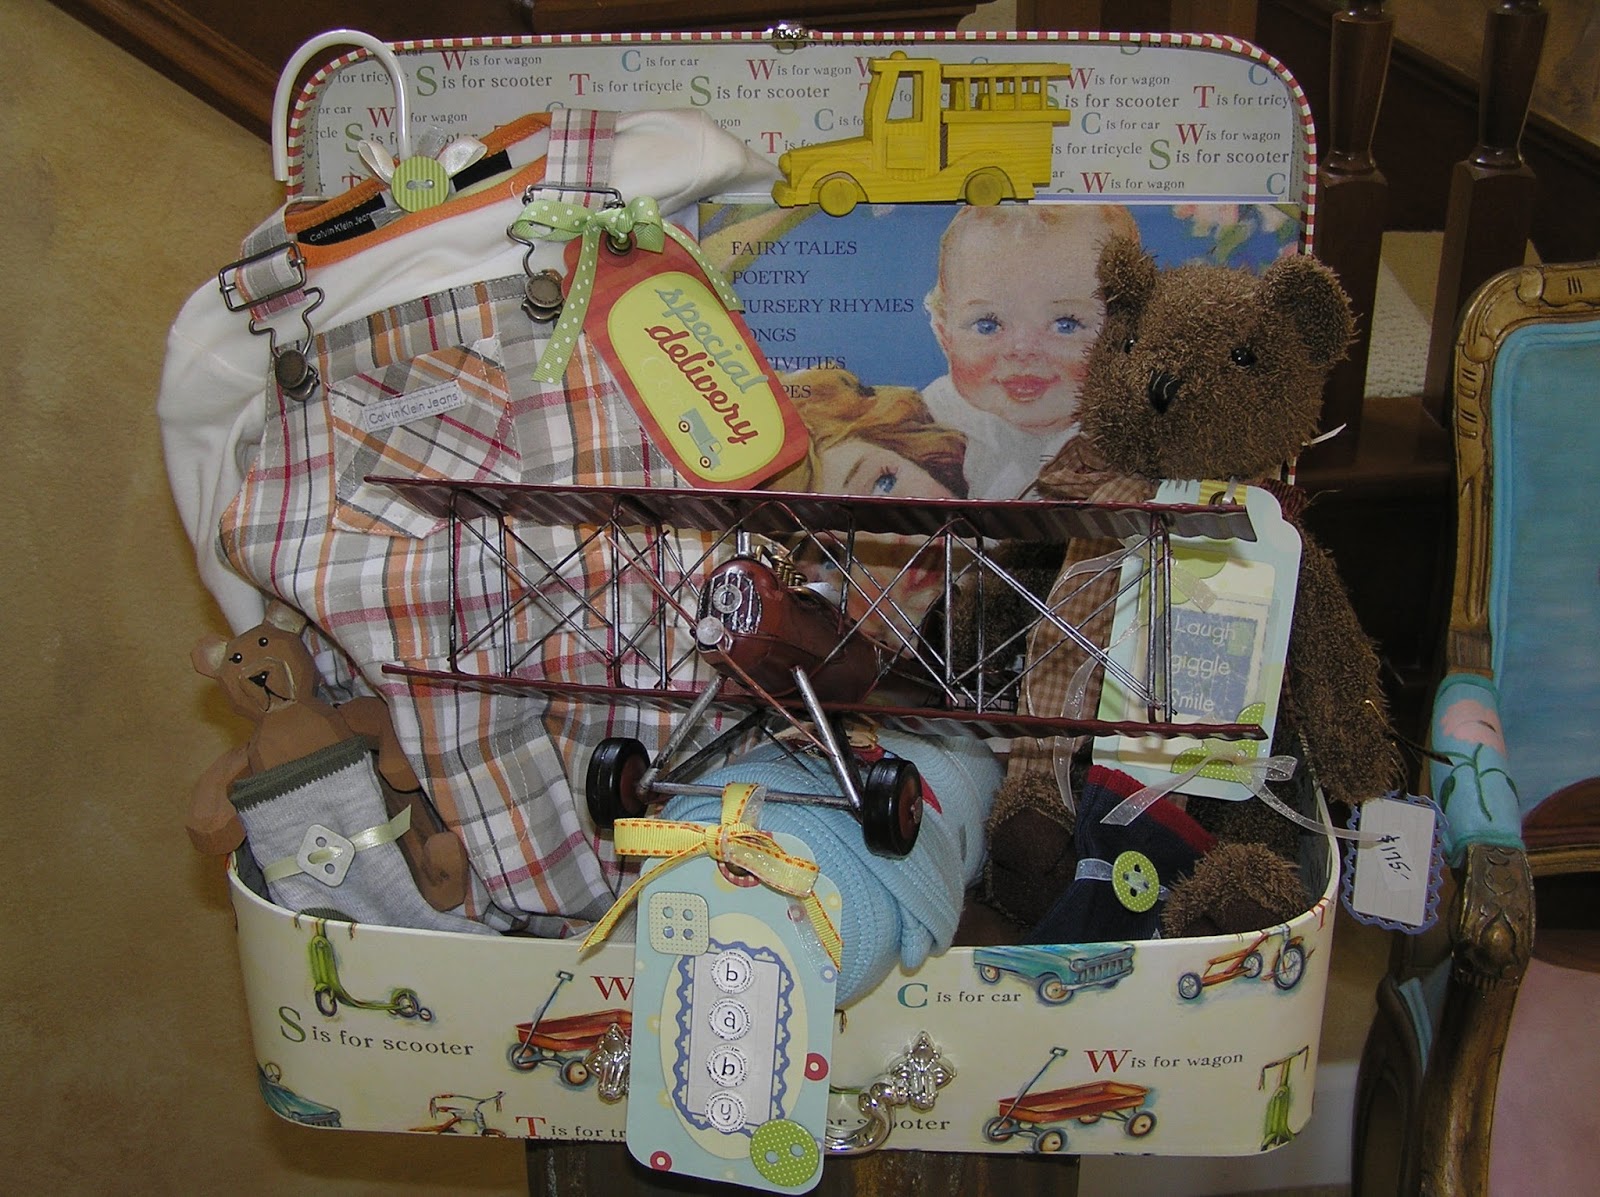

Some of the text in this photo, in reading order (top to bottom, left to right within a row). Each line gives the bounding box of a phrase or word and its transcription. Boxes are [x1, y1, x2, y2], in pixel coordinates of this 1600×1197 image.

[441, 50, 542, 71] W is for wagon
[621, 49, 699, 72] C is for car
[746, 59, 777, 80] W
[777, 65, 788, 76] is
[792, 64, 810, 75] for
[813, 66, 852, 78] wagon
[416, 66, 553, 97] S is for scooter
[569, 73, 683, 96] T is for tricycle
[690, 75, 830, 107] S is for scooter
[1095, 74, 1105, 85] is
[1109, 73, 1127, 85] for
[1131, 76, 1170, 88] wagon
[1065, 94, 1079, 108] is
[1085, 93, 1110, 108] for
[1116, 94, 1180, 108] scooter
[1193, 85, 1290, 109] T is for tricy
[334, 105, 352, 114] car
[367, 106, 396, 128] W
[411, 112, 468, 124] for wagon
[814, 108, 834, 131] C
[839, 115, 849, 126] is
[713, 118, 741, 129] agon
[1081, 112, 1160, 135] C is for car
[1175, 123, 1281, 145] W is for wagon
[760, 131, 783, 154] T
[1067, 142, 1087, 154] for
[1092, 142, 1142, 158] tricycle
[1149, 138, 1289, 170] S is for scooter
[1052, 170, 1065, 178] ar
[1080, 171, 1111, 194] W
[1111, 178, 1121, 189] is
[1125, 178, 1143, 189] for
[1147, 180, 1185, 191] wagon
[1266, 172, 1286, 195] C
[309, 213, 371, 242] Calvin Klein Jean
[731, 240, 857, 256] FAIRY TALES
[732, 270, 810, 285] POETRY
[743, 298, 914, 314] URSERY RHYMES
[654, 288, 769, 395] special
[750, 328, 797, 343] NGS
[766, 355, 847, 370] IVITIES
[644, 325, 759, 445] delivery
[427, 392, 459, 409] Jeans
[1174, 614, 1237, 645] Laugh
[1171, 651, 1231, 680] giggle
[590, 975, 635, 1001] W
[897, 982, 1021, 1008] C is for car
[278, 1005, 475, 1056] S is for scooter
[1083, 1049, 1243, 1073] W is for wagon
[515, 1116, 547, 1137] T
[551, 1125, 568, 1136] is
[574, 1125, 603, 1137] for
